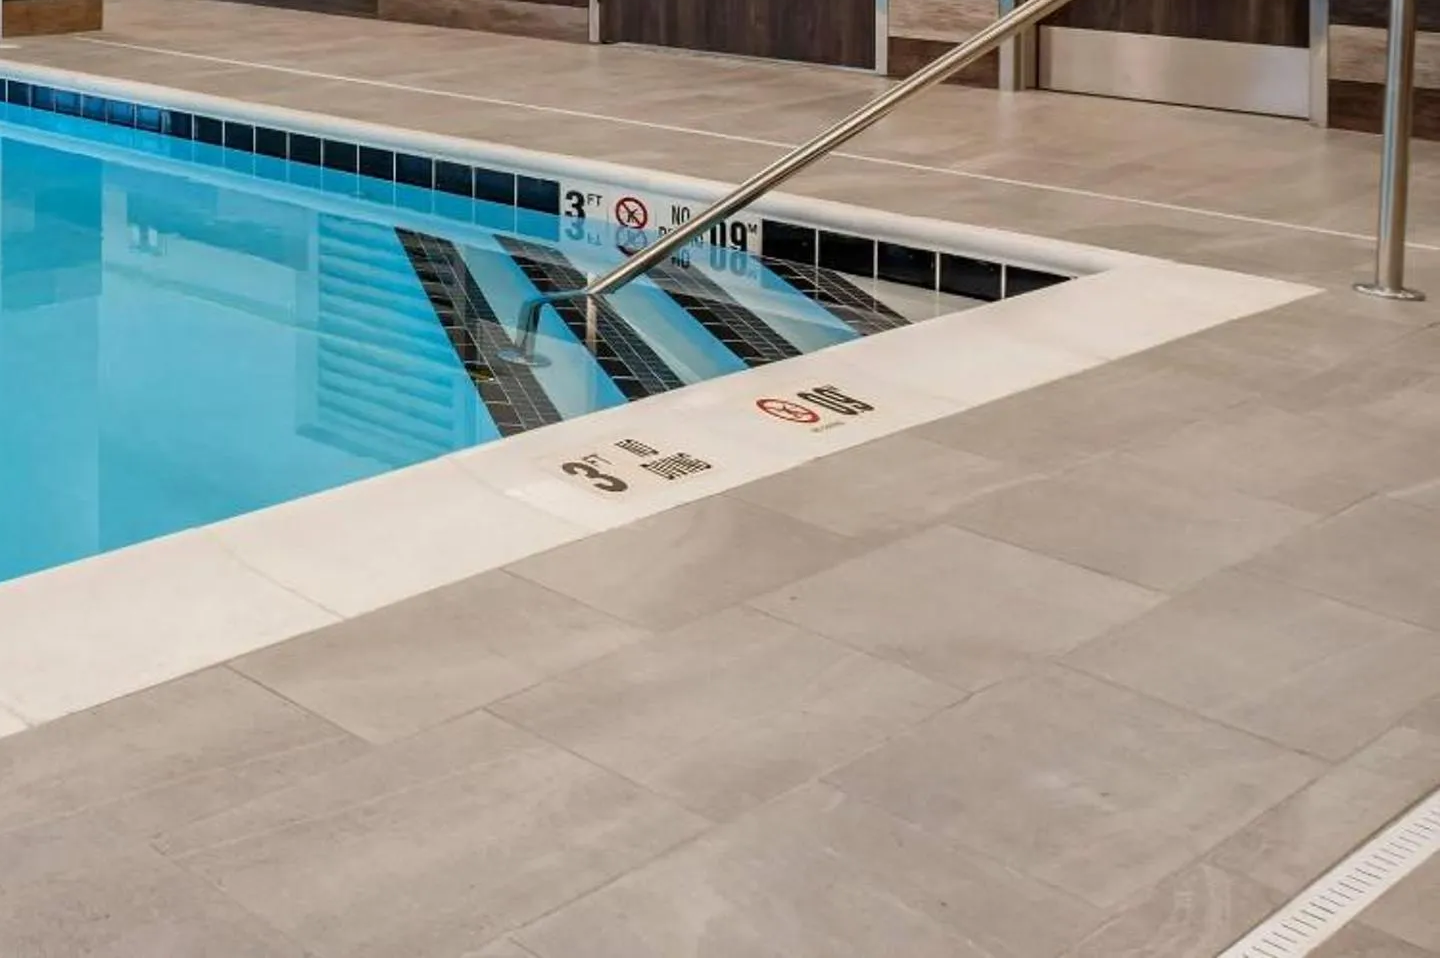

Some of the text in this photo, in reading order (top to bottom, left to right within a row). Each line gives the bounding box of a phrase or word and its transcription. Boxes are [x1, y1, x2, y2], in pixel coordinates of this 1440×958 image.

[564, 190, 604, 219] 3 FT
[671, 204, 691, 225] NO
[561, 461, 629, 493] 3
